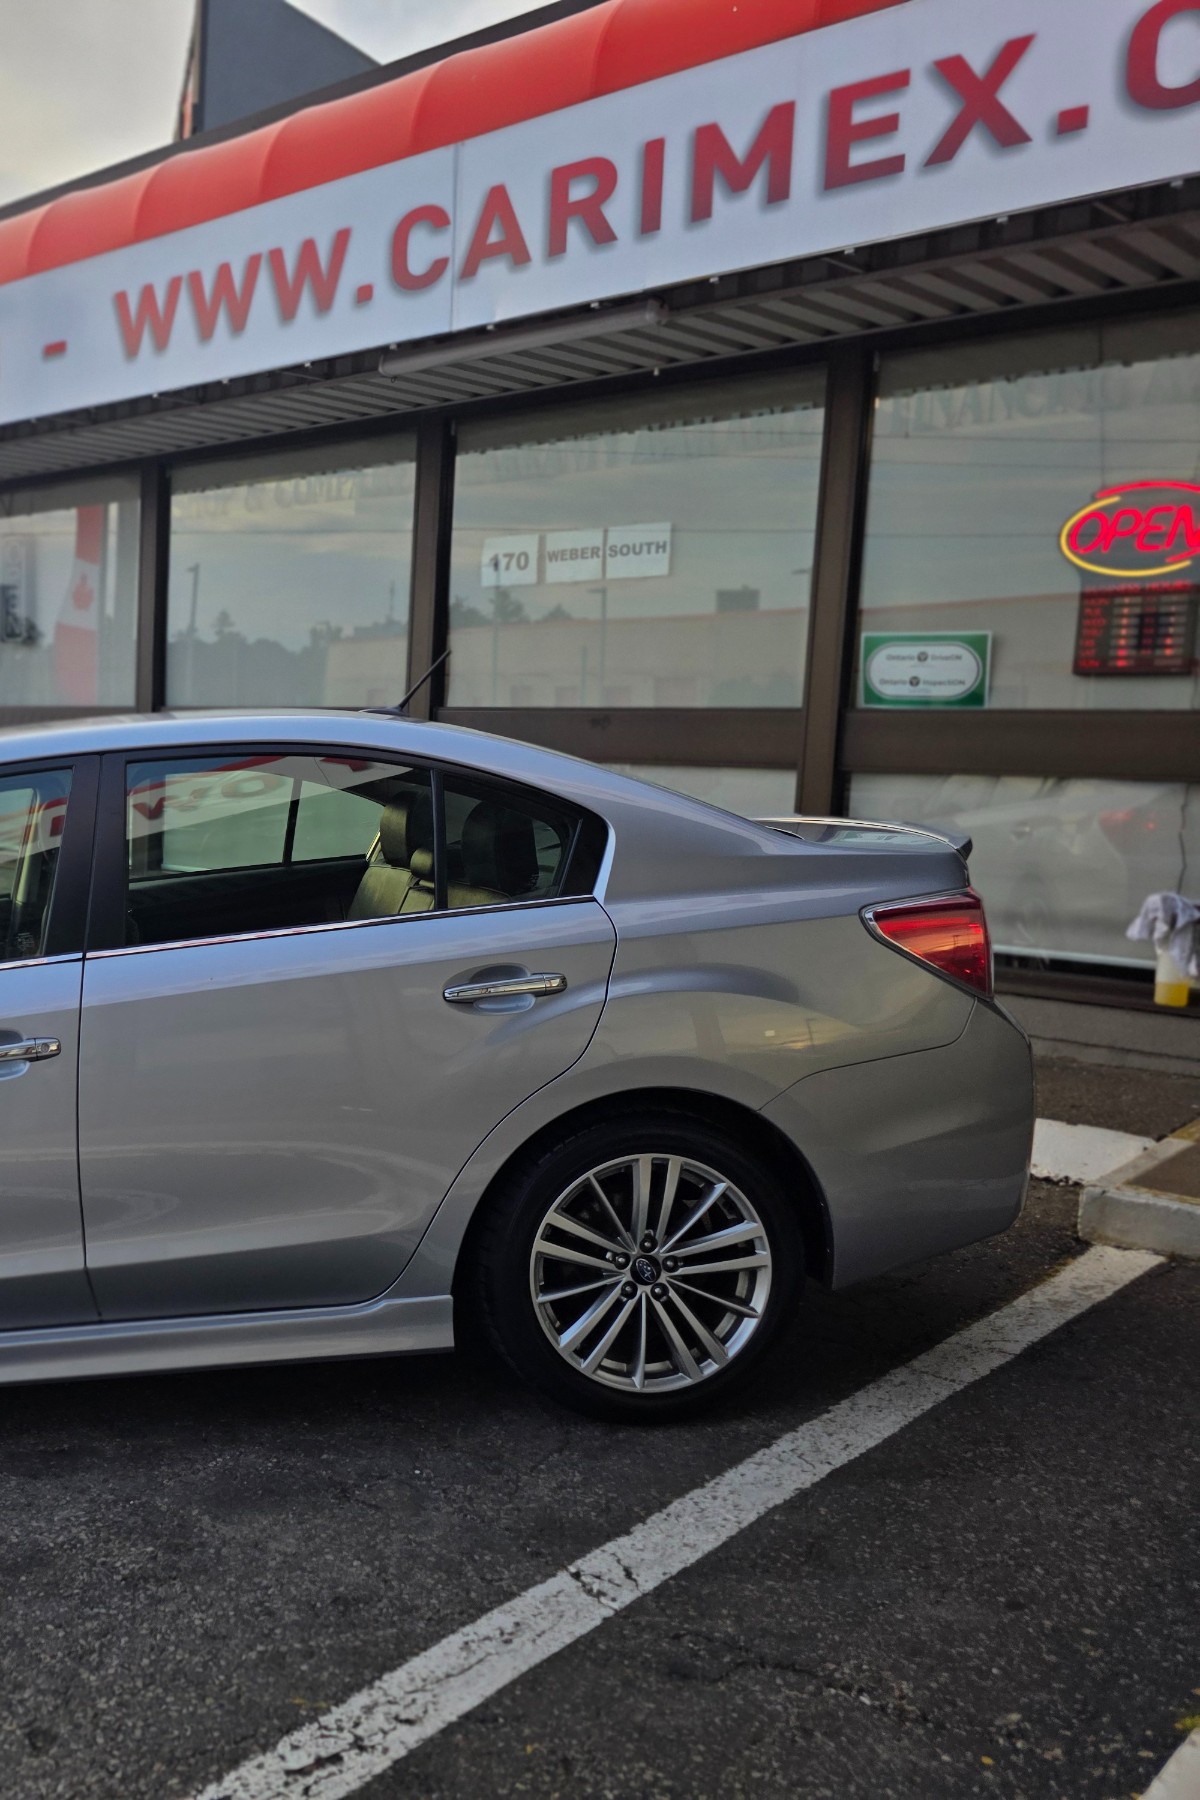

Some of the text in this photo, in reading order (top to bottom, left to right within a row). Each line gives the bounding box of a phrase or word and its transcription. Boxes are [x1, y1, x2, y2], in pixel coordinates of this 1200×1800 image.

[1069, 505, 1200, 555] OPEN
[547, 546, 600, 563] WEBER
[608, 540, 668, 558] SOUTH
